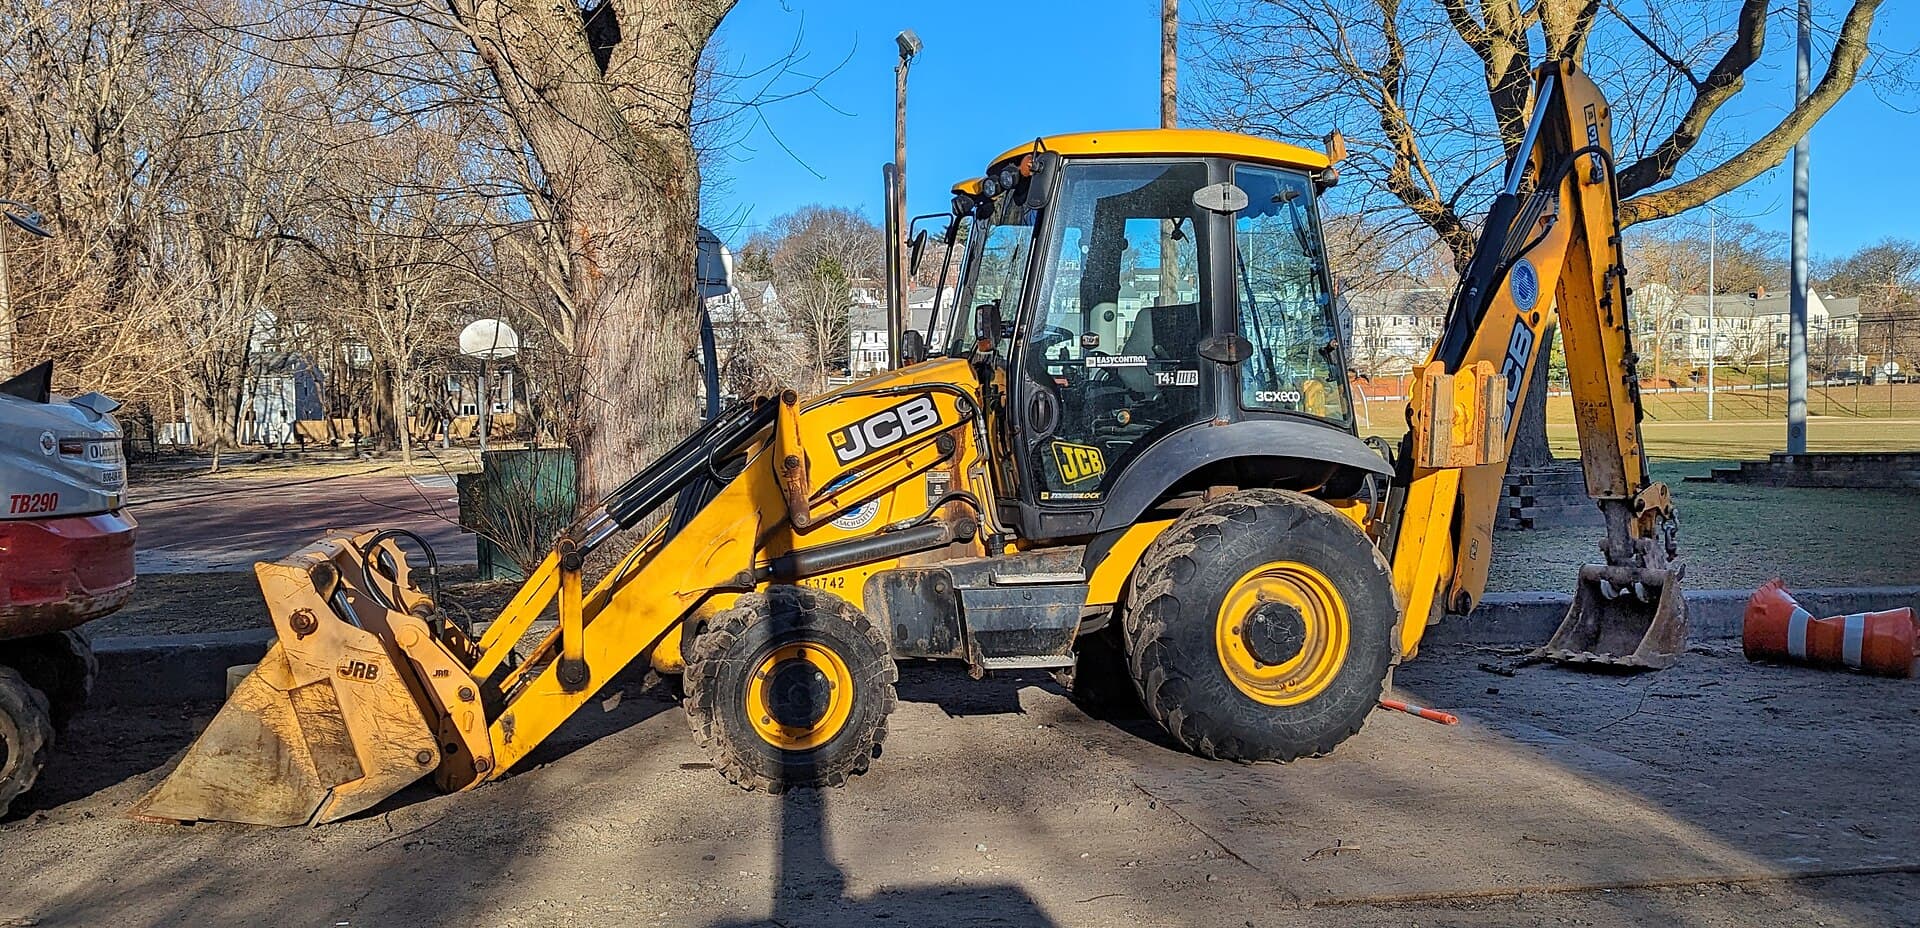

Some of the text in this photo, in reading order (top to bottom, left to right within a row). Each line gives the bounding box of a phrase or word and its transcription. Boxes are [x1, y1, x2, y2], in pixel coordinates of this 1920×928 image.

[837, 397, 938, 461] JCB
[1062, 446, 1102, 480] JCB
[10, 493, 59, 514] TB290
[340, 660, 380, 681] JRB
